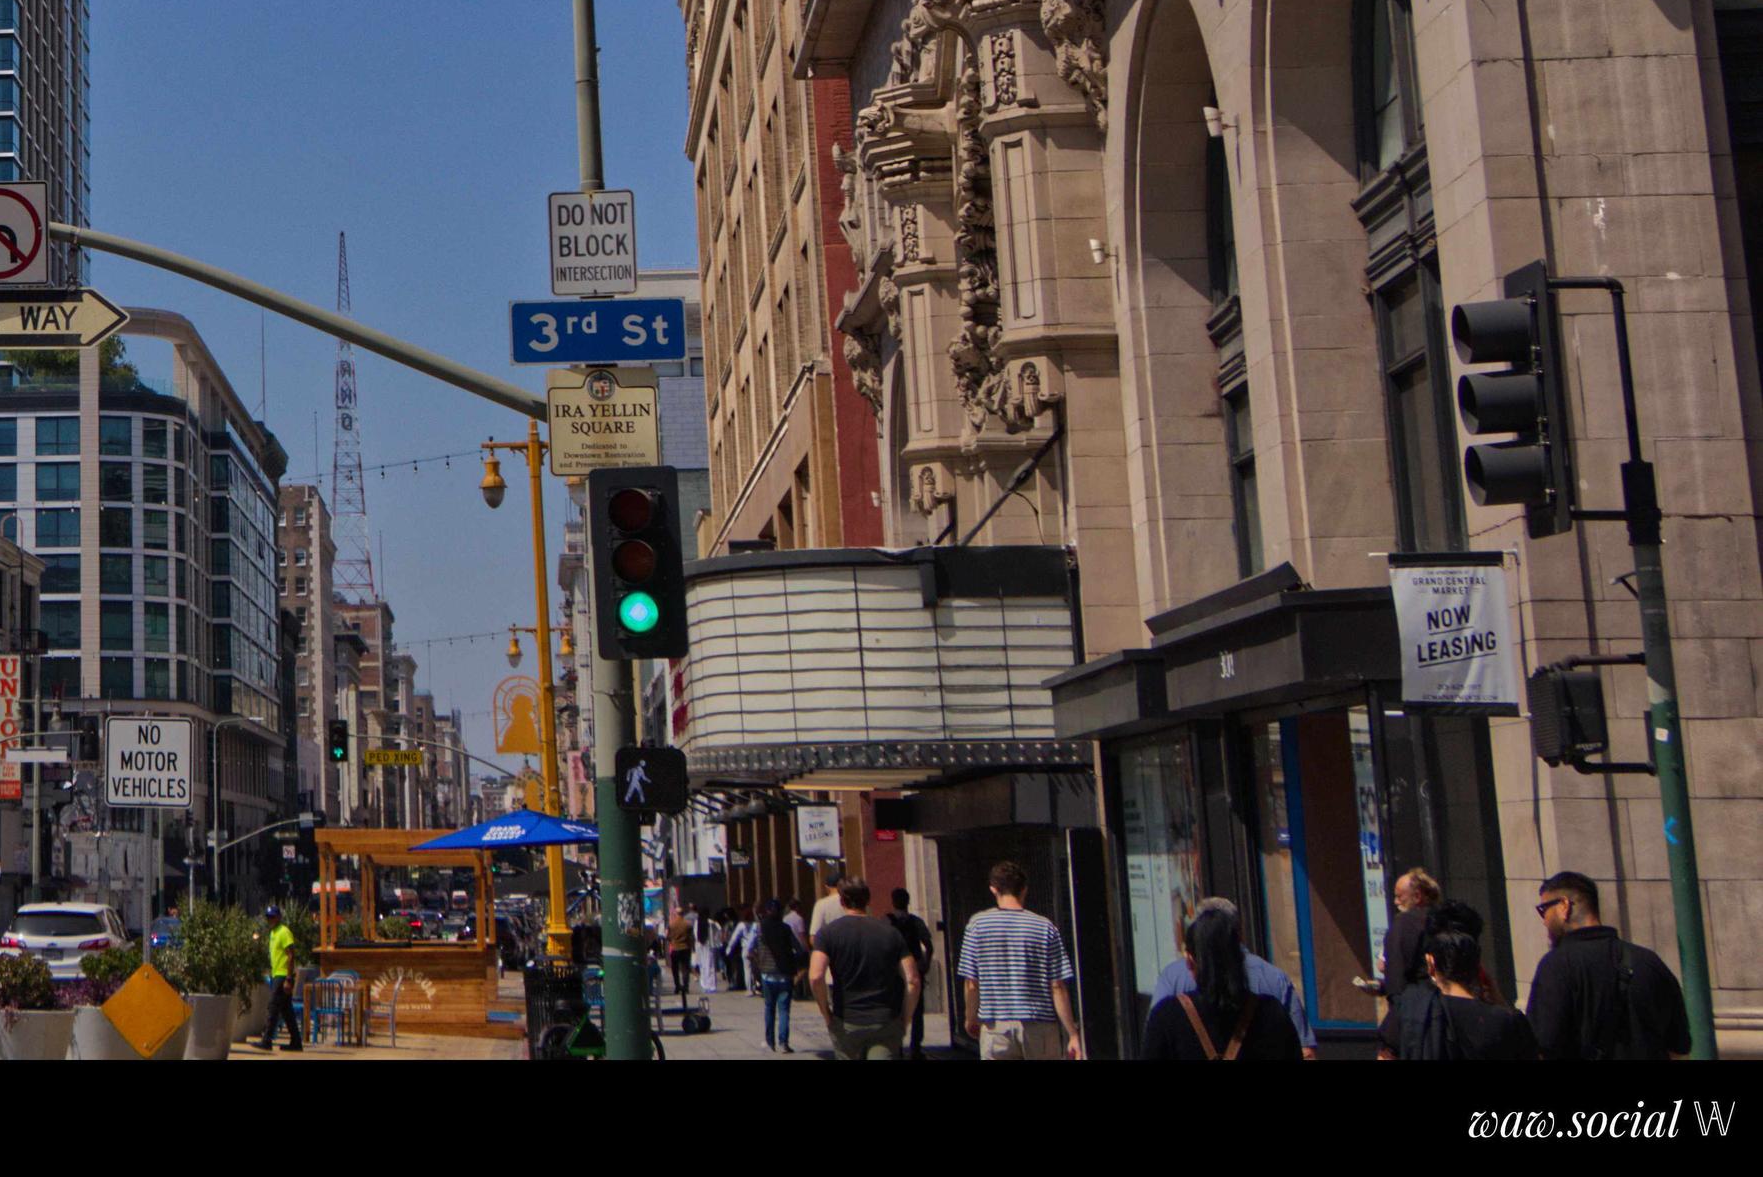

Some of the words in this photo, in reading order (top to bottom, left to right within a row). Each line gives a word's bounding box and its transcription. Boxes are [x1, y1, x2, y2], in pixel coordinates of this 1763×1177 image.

[557, 204, 584, 226] DO
[590, 202, 627, 225] NOT
[558, 234, 629, 257] BLOCK
[555, 265, 632, 281] INTERSECTION
[20, 306, 78, 331] WAY
[528, 311, 597, 353] 3rd
[622, 314, 669, 346] St
[554, 404, 585, 418] IRA
[588, 403, 651, 417] YELLIN
[571, 421, 636, 436] SQUARE
[1413, 577, 1443, 586] GRAND
[1445, 576, 1487, 585] CENTRAL
[1432, 586, 1470, 595] MARKET
[1427, 605, 1471, 630] NOW
[1417, 631, 1497, 663] LEASING
[138, 725, 161, 744] NO
[120, 751, 178, 772] MOTOR
[369, 752, 390, 762] PED
[394, 752, 418, 762] XING
[112, 777, 186, 799] VEHICLES
